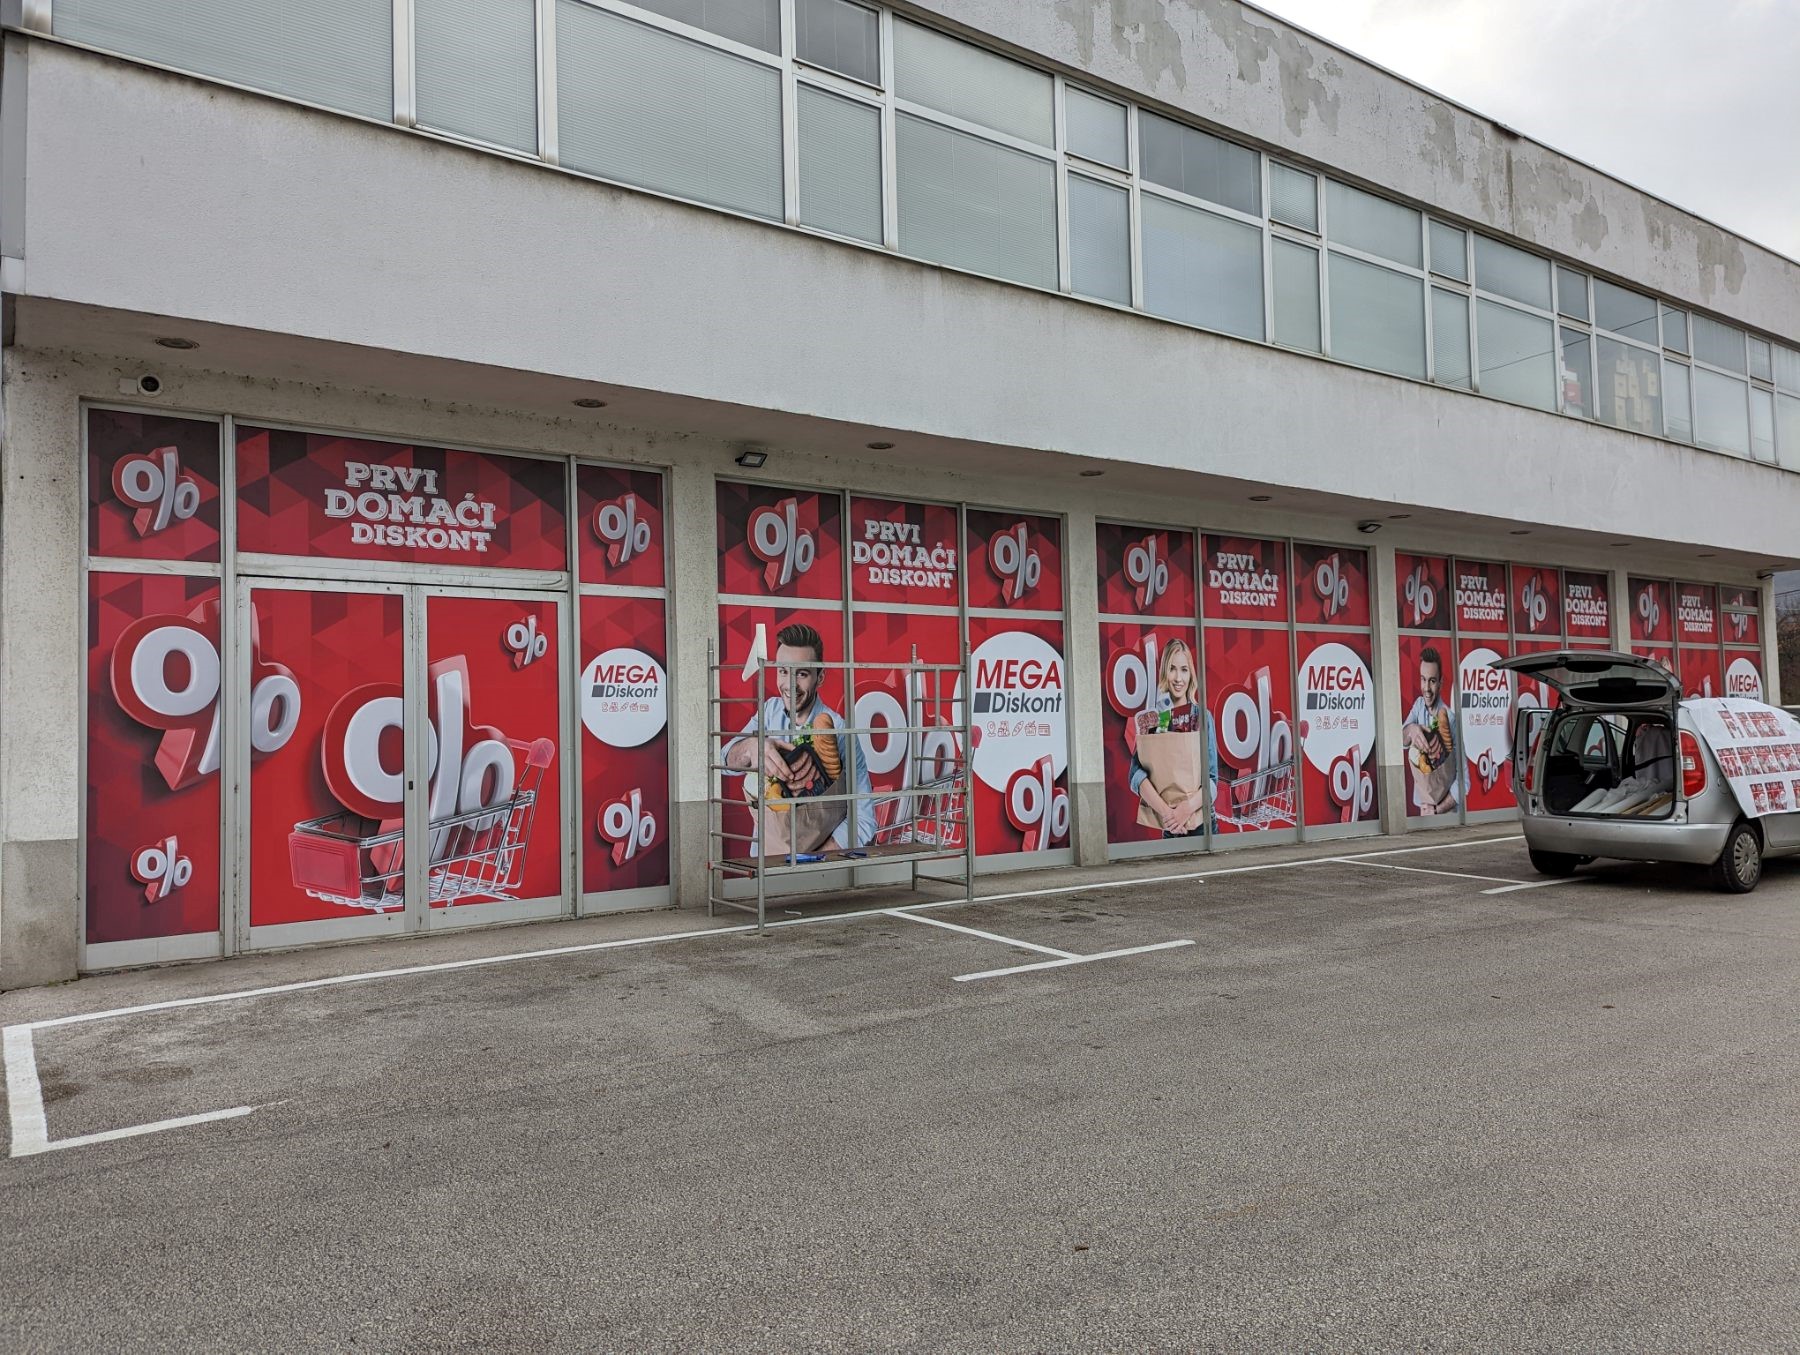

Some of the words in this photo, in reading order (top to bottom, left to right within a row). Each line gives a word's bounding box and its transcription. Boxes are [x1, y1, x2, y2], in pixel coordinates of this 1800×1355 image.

[345, 461, 438, 494] PRVI
[324, 488, 496, 529] DOMAĆI
[351, 522, 491, 551] DISKONT
[865, 520, 920, 543] PRVI
[853, 541, 956, 570] DOMAĆI
[1217, 552, 1254, 571] PRVI
[868, 567, 953, 588] DISKONT
[1210, 569, 1278, 592] DOMAĆI
[1460, 575, 1487, 590] PRVI
[1220, 590, 1277, 606] DISKONT
[1455, 588, 1505, 608] DOMAĆI
[1569, 585, 1592, 598] PRVI
[1463, 607, 1504, 620] DISKONT
[1571, 614, 1606, 626] DISKONT
[594, 665, 658, 683] MEGA
[976, 659, 1061, 689] MEGA
[1308, 666, 1365, 690] MEGA
[1462, 669, 1509, 691] MEGA
[1729, 675, 1758, 692] MEGA
[605, 685, 658, 697] Diskont
[1319, 693, 1365, 709] Diskont
[1470, 693, 1509, 708] Diskont
[992, 692, 1062, 713] Diskont
